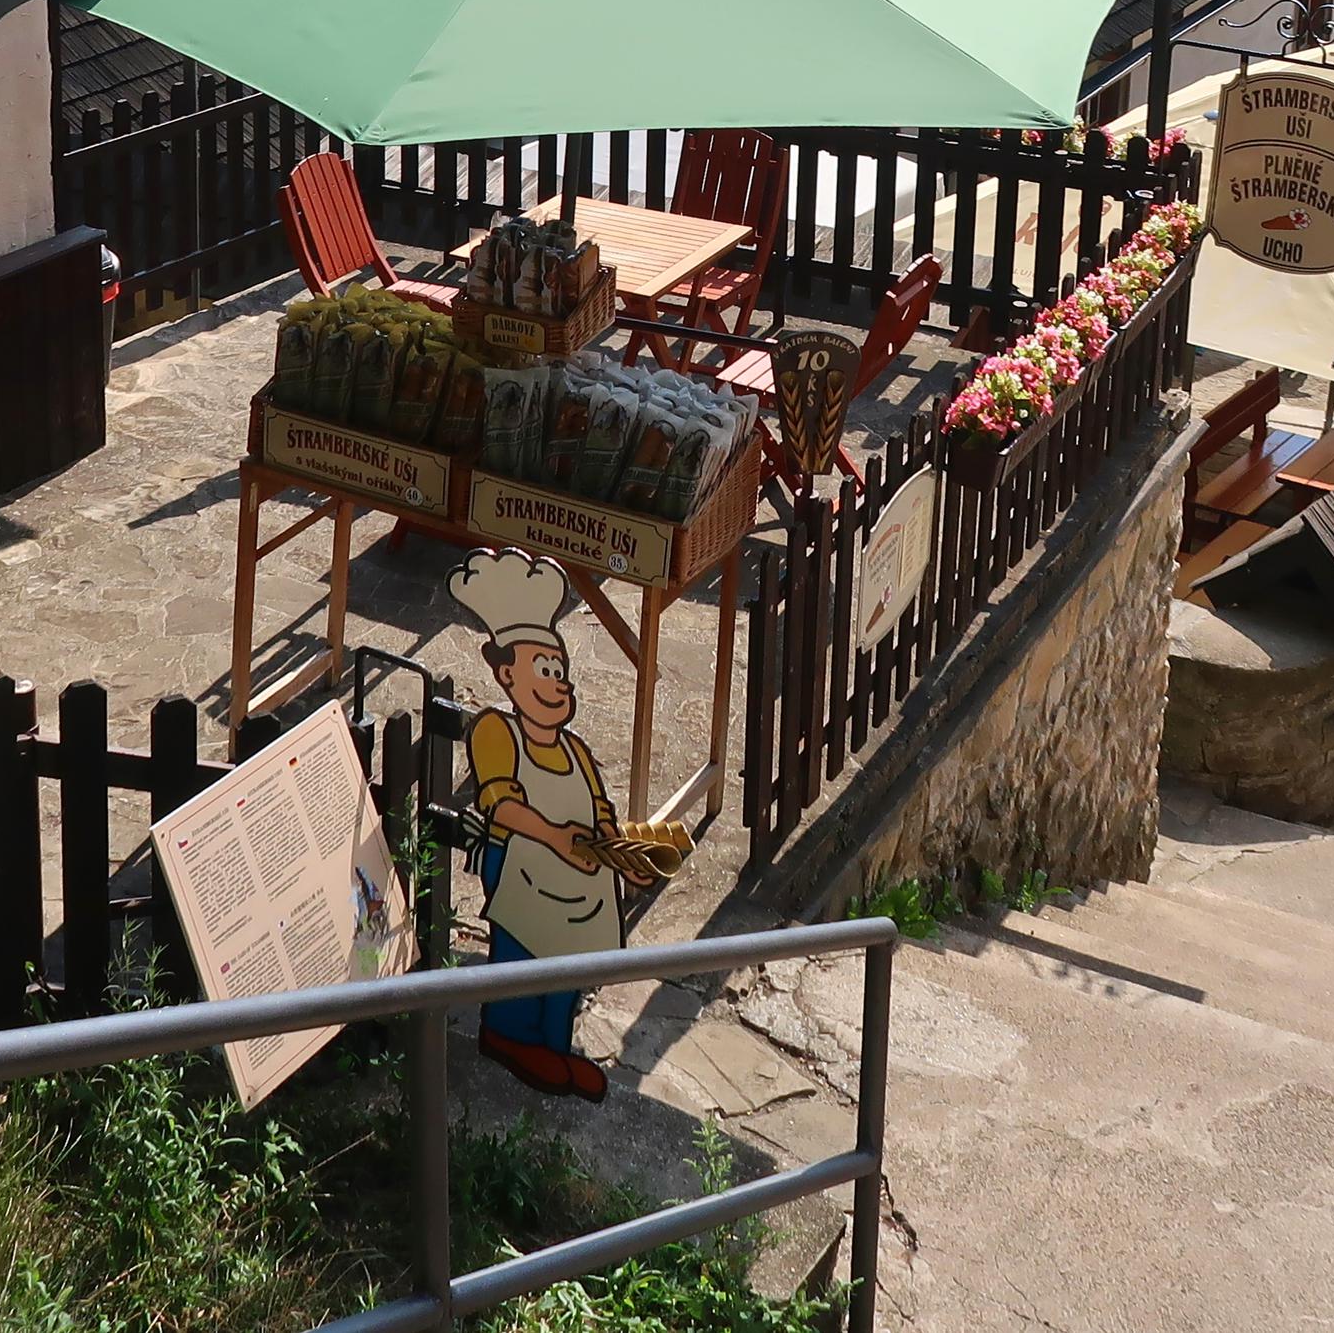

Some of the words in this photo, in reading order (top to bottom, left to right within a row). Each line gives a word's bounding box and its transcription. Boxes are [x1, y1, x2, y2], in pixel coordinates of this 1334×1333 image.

[1286, 110, 1313, 140] UŠI
[1264, 151, 1324, 185] PLNĚNÉ
[1262, 236, 1304, 264] UCHO
[797, 350, 831, 372] 10
[287, 422, 390, 472] ŠTRAMBERSKÉ
[393, 456, 419, 486] UŠI
[306, 457, 363, 484] vlašskými
[366, 474, 404, 499] oříšky
[495, 490, 607, 544] ŠTRAMBERSKÉ
[610, 526, 638, 560] UŠI
[525, 525, 604, 561] klasické
